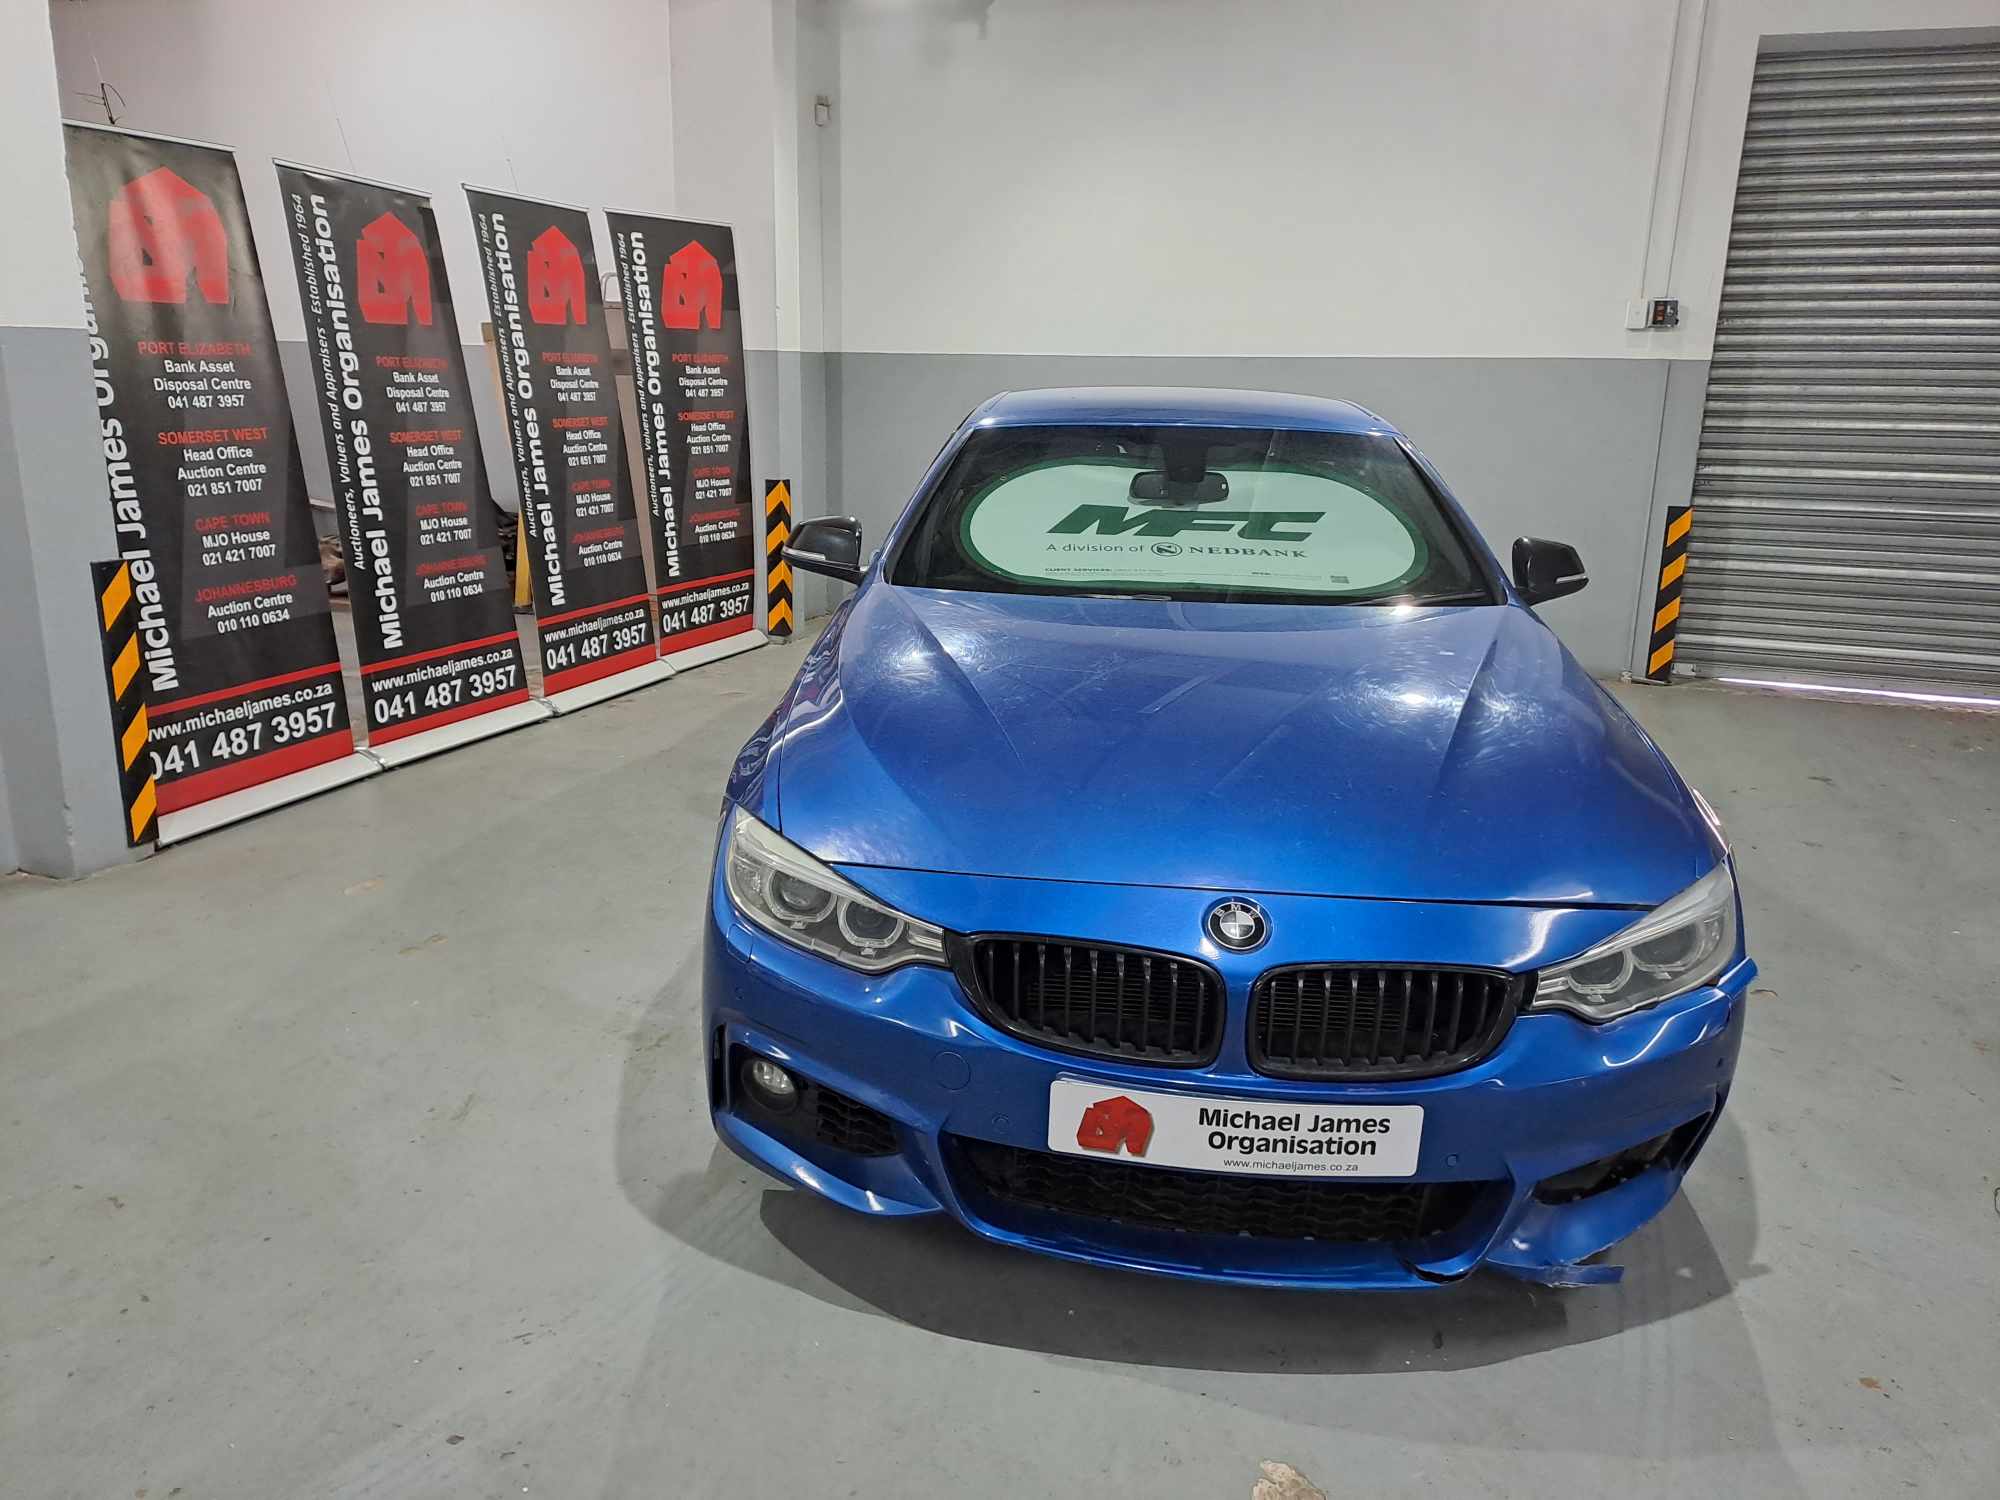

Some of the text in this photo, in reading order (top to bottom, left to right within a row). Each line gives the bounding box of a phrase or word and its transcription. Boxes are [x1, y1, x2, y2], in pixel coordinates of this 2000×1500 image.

[297, 233, 322, 314] Established
[137, 341, 175, 355] PORT
[164, 359, 235, 373] Bank Asset
[317, 327, 338, 400] Appraisers
[153, 377, 252, 393] Disposal Centre
[393, 371, 416, 383] Bank
[678, 377, 706, 387] Disposal
[168, 394, 245, 408] 041 487 3957
[386, 387, 449, 399] Disposal Centre
[396, 402, 410, 413] 041
[492, 213, 566, 606] Michael James Organisation
[508, 392, 518, 416] and
[631, 231, 680, 577] Michael James Organisation
[310, 194, 404, 649] Michael James Organisation
[328, 402, 342, 430] and
[158, 427, 268, 445] SOMERSET WEST
[513, 420, 526, 462] Valuers
[183, 446, 253, 462] Head Office
[335, 433, 351, 484] Valuers
[407, 444, 454, 457] Head Office
[563, 444, 587, 453] Auction
[178, 463, 266, 480] Auction Centre
[403, 459, 462, 472] Auction Centre
[187, 479, 262, 497] 021 851 7007
[409, 476, 424, 487] 021
[426, 475, 441, 486] 851
[420, 516, 468, 530] MJO House
[1045, 503, 1326, 542] MFC
[202, 530, 271, 548] MJO House
[420, 528, 472, 545] 021 421 7007
[101, 418, 179, 692] Michael James
[202, 543, 276, 566] 021 421 7007
[579, 544, 602, 555] Auction
[1045, 543, 1308, 558] A division of NEDBANK
[424, 570, 484, 589] Auction Centre
[430, 584, 482, 602] 010 110 0634
[661, 582, 749, 609] www.michaeljames.co.za
[208, 593, 293, 618] Auction Centre
[662, 594, 749, 633] 041 487 3957
[217, 608, 290, 634] 010 110 0634
[544, 608, 645, 643] www.michaeljames.co.za
[546, 623, 647, 670] 041 487 3957
[371, 648, 512, 693] www.michaeljames.co.za
[374, 665, 516, 724] 041 487 3957
[148, 683, 333, 742] ww.michaeljames.co.za
[212, 722, 263, 759] 487
[271, 702, 336, 743] 3957
[1199, 1107, 1391, 1134] Michael James
[1208, 1131, 1377, 1156] Organisation
[1223, 1158, 1358, 1172] www.michaeljames.co.za
